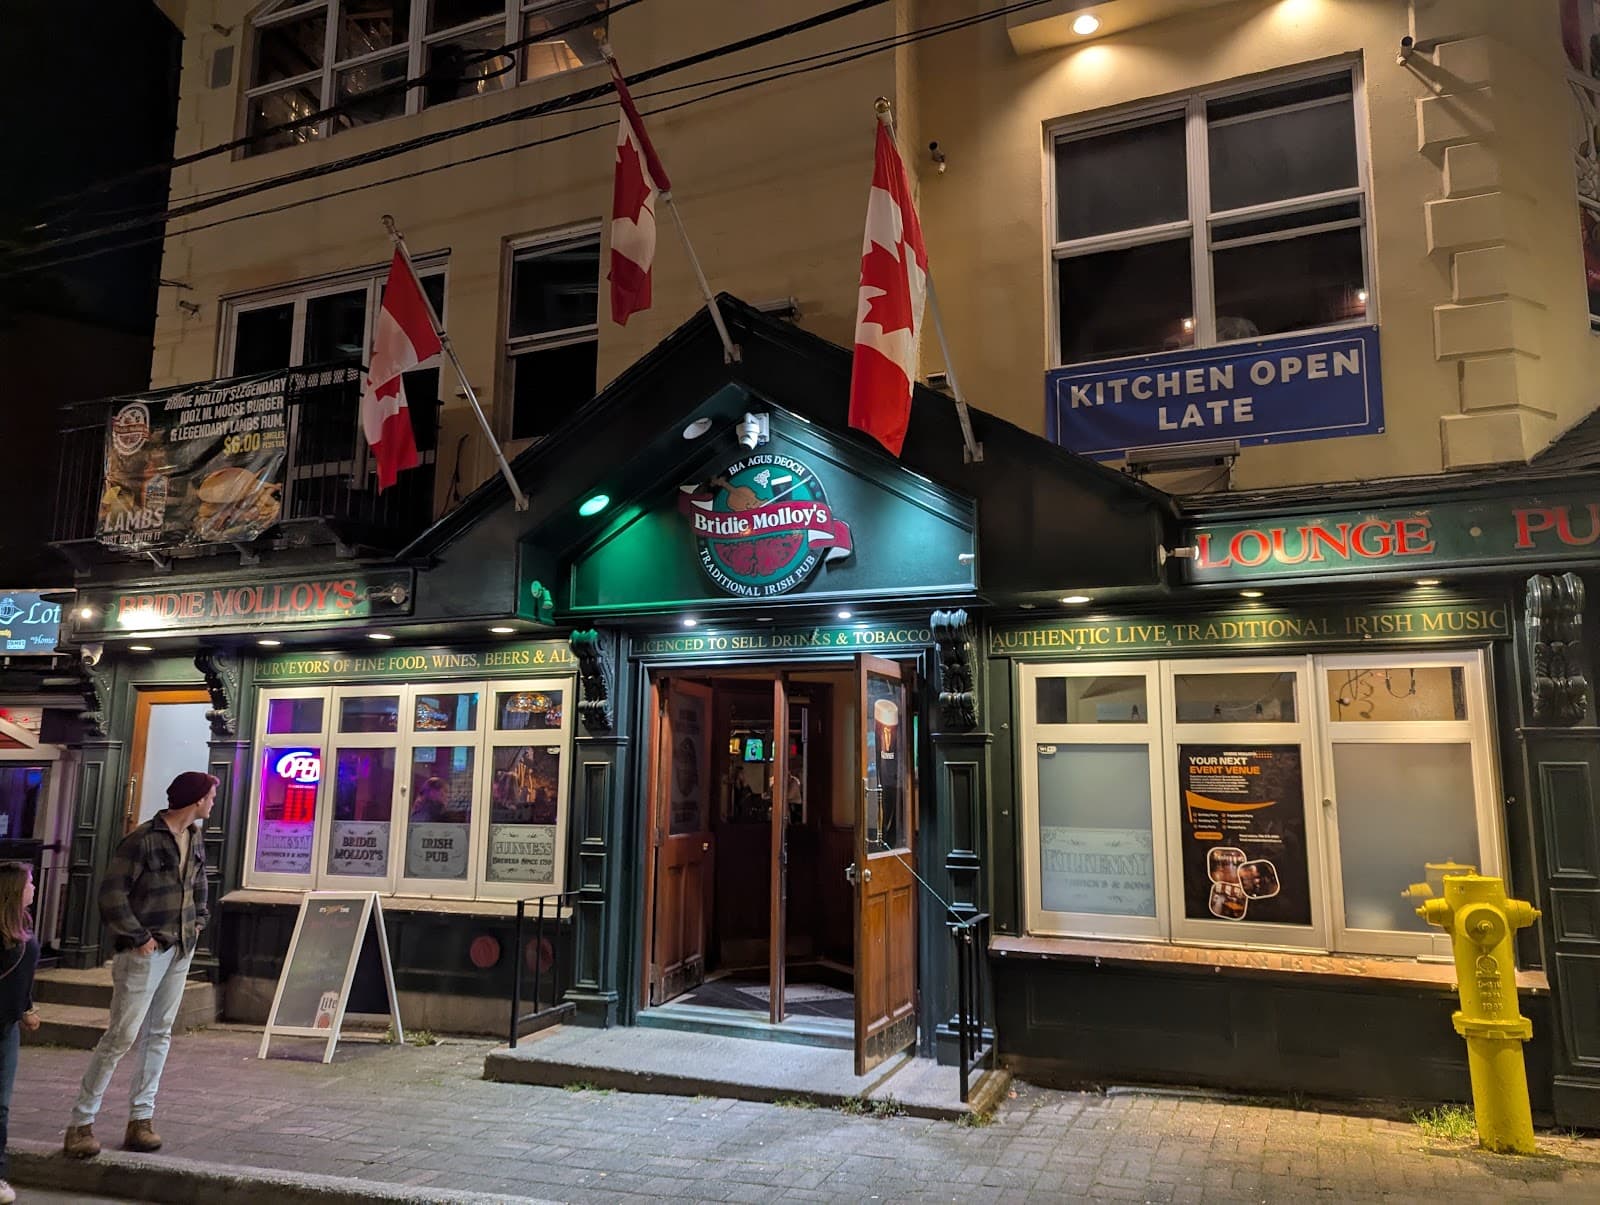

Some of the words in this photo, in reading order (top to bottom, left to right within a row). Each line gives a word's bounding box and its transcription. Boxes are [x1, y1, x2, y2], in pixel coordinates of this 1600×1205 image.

[236, 378, 287, 399] LEGENDARY
[1071, 365, 1234, 409] KITCHEN
[1250, 349, 1360, 386] OPEN
[214, 401, 245, 418] MOOSE
[247, 396, 284, 413] BURGER
[1158, 397, 1254, 431] LATE
[178, 421, 228, 440] LEGENDARY
[230, 416, 259, 433] LAMBS
[223, 433, 260, 457] $6.00
[728, 462, 746, 476] BIA
[747, 455, 772, 467] AGUS
[773, 455, 805, 475] DEOCH
[103, 508, 163, 532] LAMBS
[694, 512, 749, 535] Bridie
[752, 504, 827, 531] Molloy's
[1195, 517, 1436, 569] LOUNGE
[700, 547, 761, 597] TRADITIONAL
[764, 577, 796, 595] IRISH
[795, 555, 816, 578] PUB
[117, 590, 205, 621] BRIDIE
[210, 579, 357, 617] MOLLOY'S
[991, 627, 1110, 648] AUTHENTIC
[1115, 625, 1167, 643] LIVE
[1172, 617, 1336, 642] TRADITIONAL
[1345, 613, 1412, 634] IRISH
[1421, 609, 1505, 632] MUSIC
[633, 639, 703, 653] LICENCED
[708, 637, 727, 649] TO
[731, 635, 767, 649] SELL
[772, 631, 831, 647] DRINKS
[836, 632, 848, 645] &
[853, 629, 931, 645] TOBACCO
[256, 659, 330, 676] PURVEYORS
[333, 659, 350, 673] OF
[354, 658, 386, 672] FINE
[388, 655, 428, 671] FOOD,
[432, 653, 480, 668] WINES,
[484, 650, 529, 666] BEERS
[533, 649, 545, 663] &
[280, 756, 320, 779] OPEN
[1189, 756, 1218, 765] YOUR
[1219, 757, 1248, 765] NEXT
[1189, 765, 1224, 774] EVENT
[1225, 766, 1261, 775] VENUE
[343, 837, 377, 847] BRIDIE
[421, 838, 453, 849] IRISH
[495, 841, 552, 855] GUINNESS
[334, 849, 383, 861] MOLLOY'S
[425, 851, 449, 862] PUB
